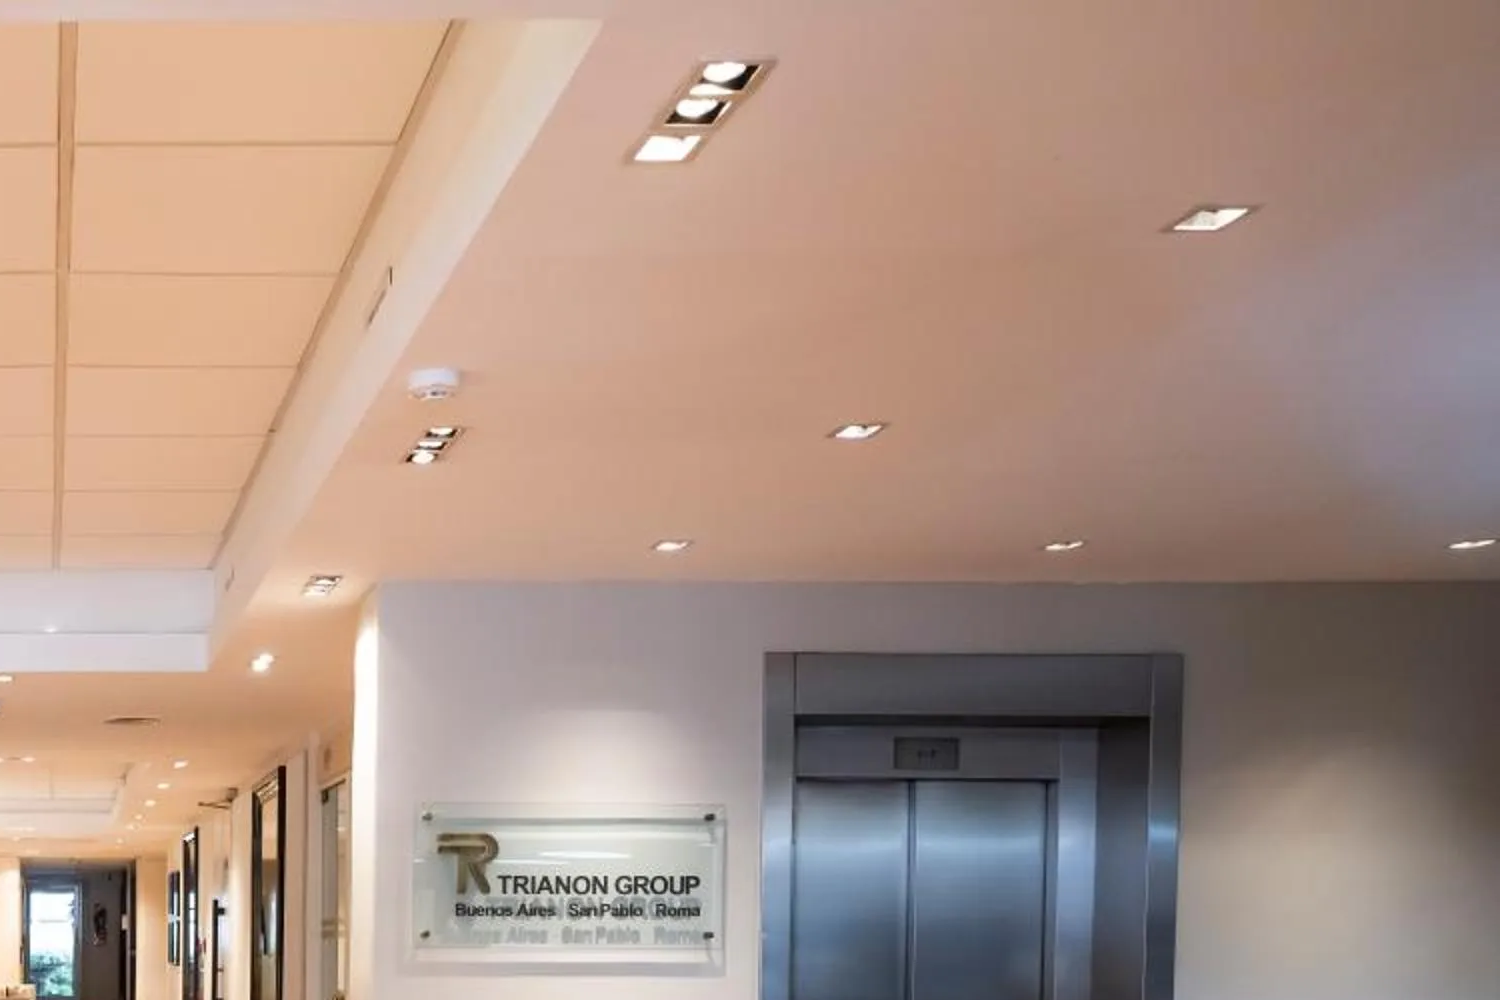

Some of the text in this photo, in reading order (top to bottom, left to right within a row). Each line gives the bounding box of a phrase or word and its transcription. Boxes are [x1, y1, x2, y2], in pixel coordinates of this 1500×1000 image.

[497, 875, 701, 895] TRIANON GROUP
[454, 903, 701, 917] Buenos Aires San Pablo Roma
